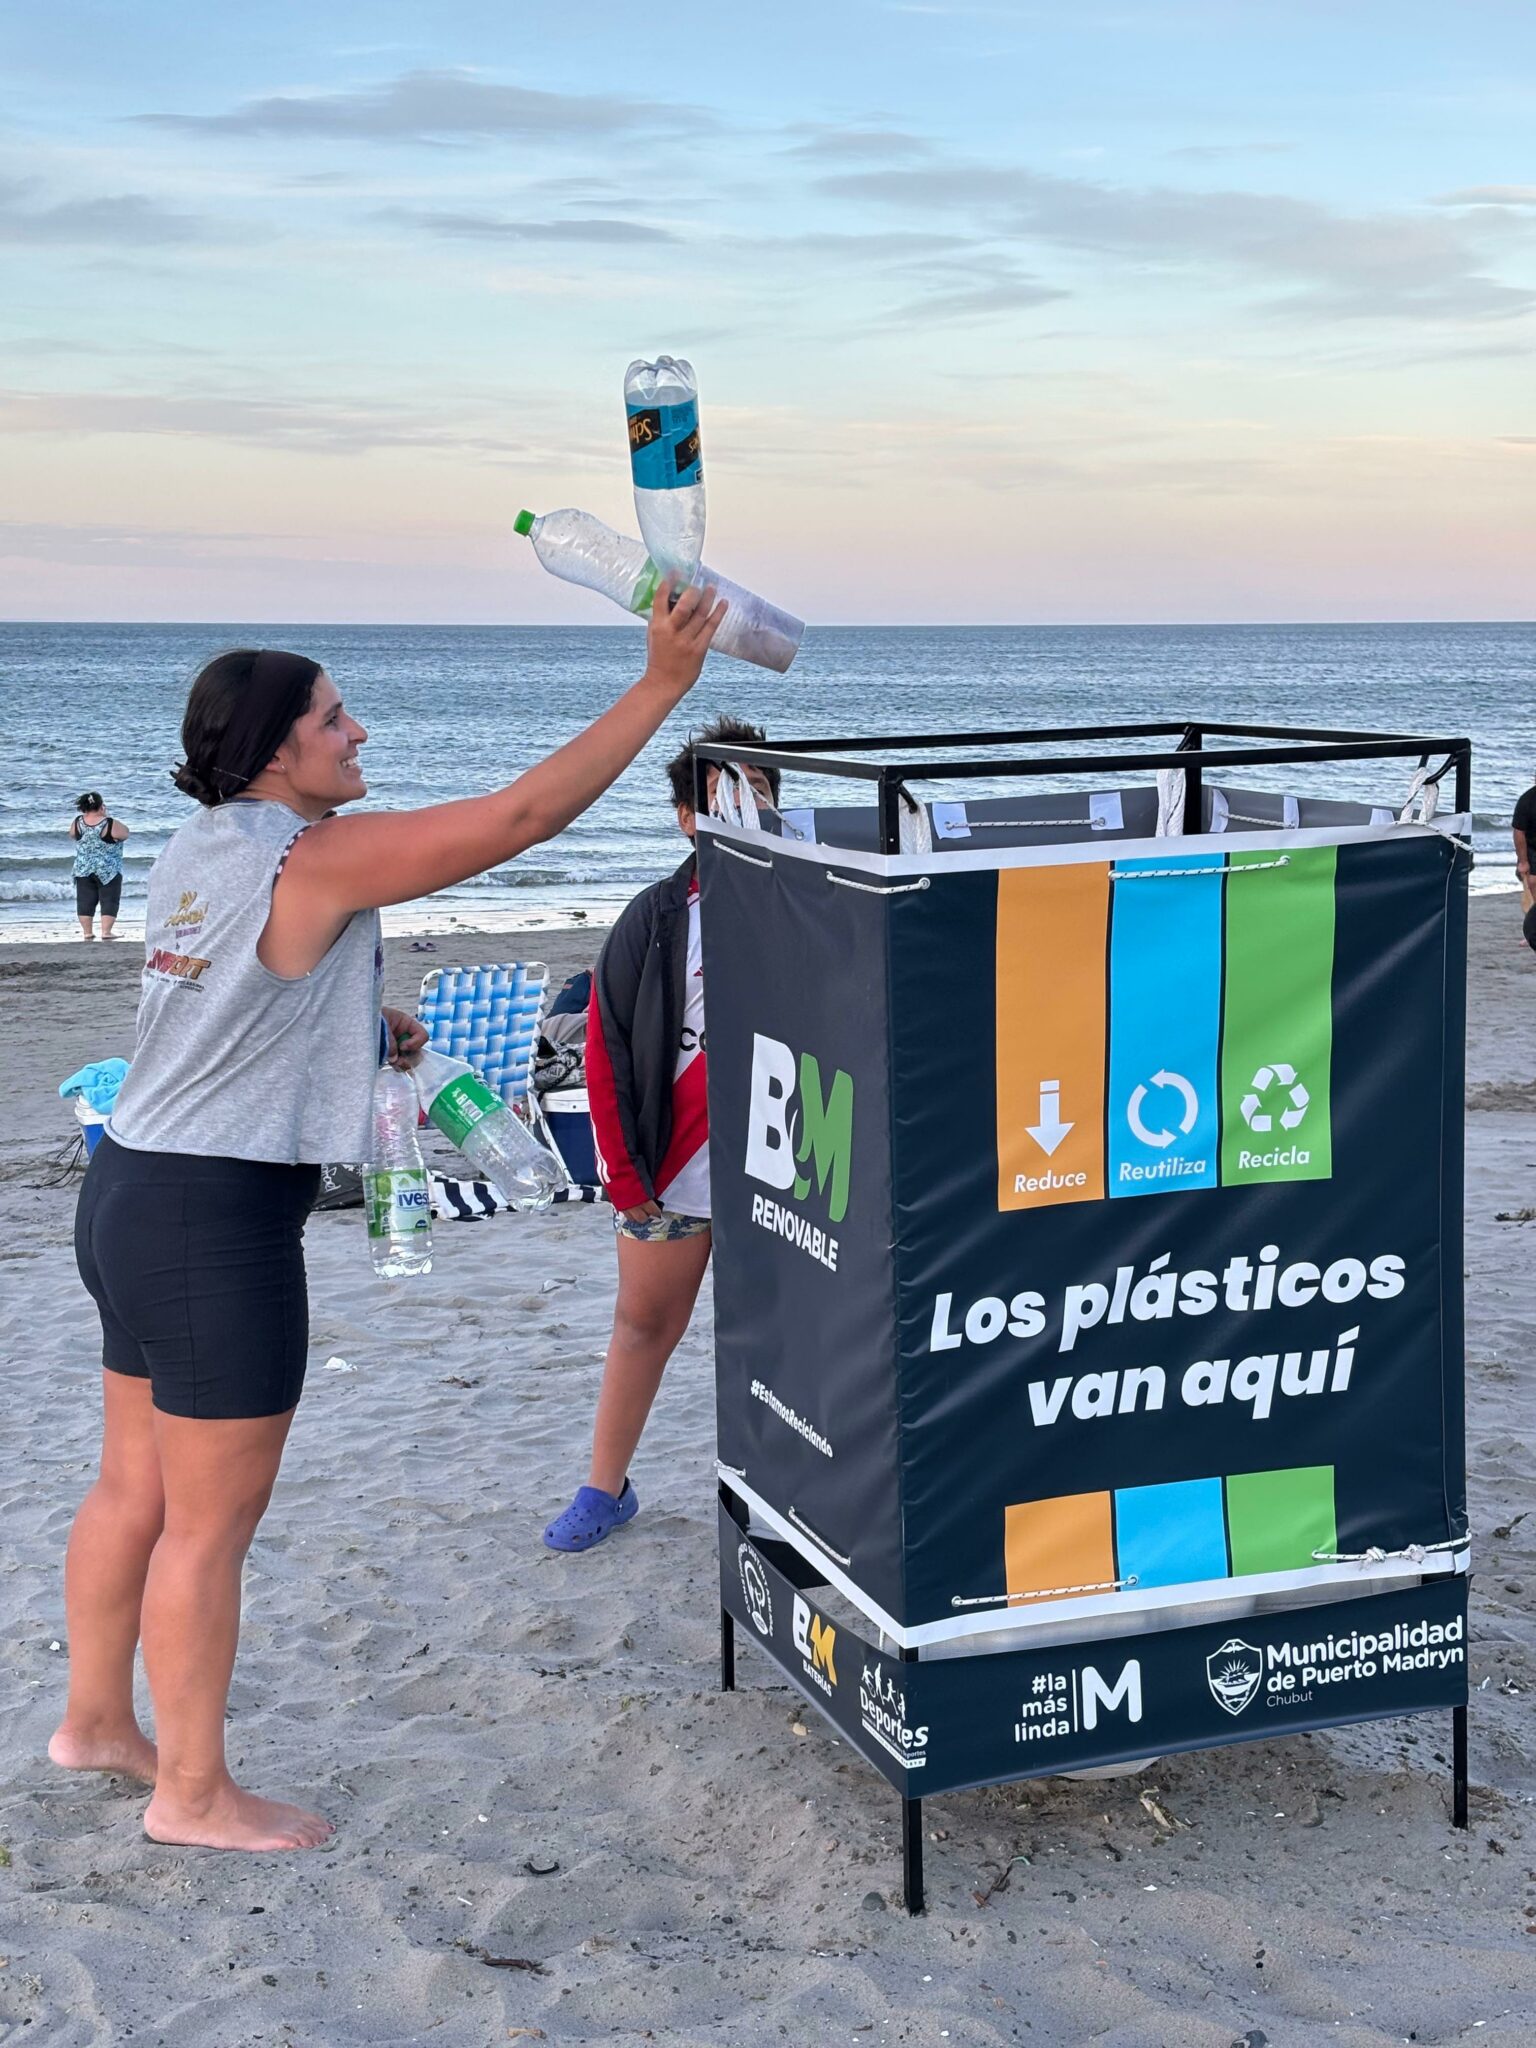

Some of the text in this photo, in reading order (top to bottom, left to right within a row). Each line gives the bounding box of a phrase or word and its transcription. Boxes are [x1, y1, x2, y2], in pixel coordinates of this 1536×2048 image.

[1118, 1157, 1207, 1182] Reutiliza
[1238, 1145, 1311, 1169] Recicla
[1014, 1169, 1087, 1193] Reduce
[751, 1193, 839, 1272] RENOVABLE
[930, 1244, 1406, 1353] Los plásticos
[1027, 1326, 1360, 1427] van aquí
[750, 1378, 834, 1459] #EstamosReciclando
[1267, 1614, 1463, 1670] Municipalidad
[802, 1660, 832, 1698] BATERÍAS
[1031, 1671, 1067, 1695] #la
[1266, 1645, 1464, 1692] de Puerto Madryn
[1022, 1694, 1068, 1716] más
[1081, 1659, 1142, 1731] M
[1266, 1689, 1313, 1708] Chubut
[859, 1686, 929, 1749] Deportes
[1014, 1718, 1070, 1743] linda
